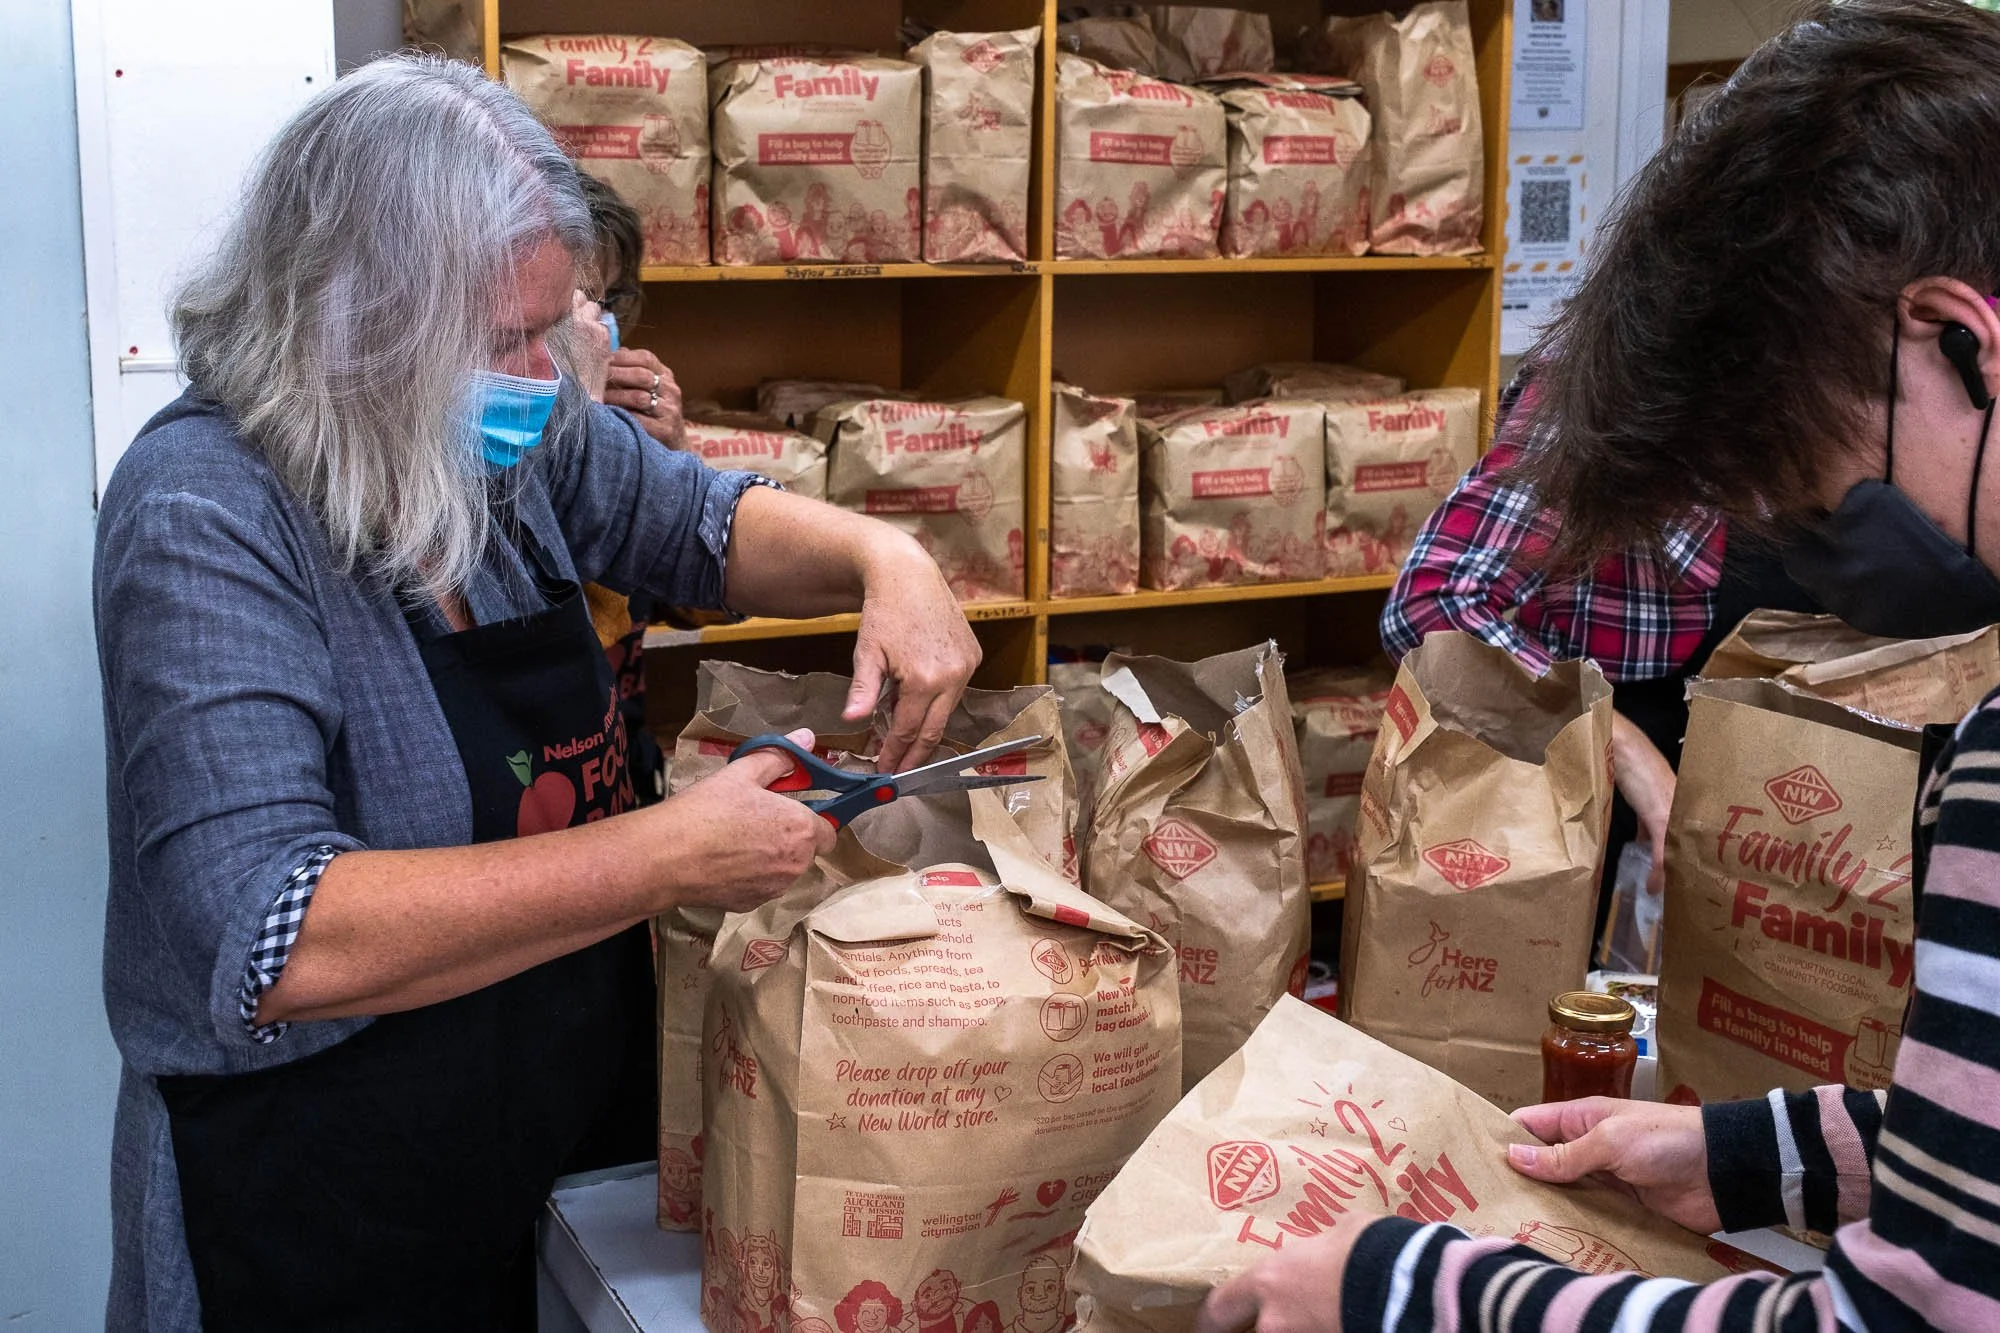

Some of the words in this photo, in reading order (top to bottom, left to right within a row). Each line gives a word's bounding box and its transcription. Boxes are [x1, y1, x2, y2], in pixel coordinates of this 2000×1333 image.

[637, 36, 653, 56] 2
[566, 59, 670, 95] Family
[774, 69, 880, 101] Family
[768, 139, 784, 149] Fill
[793, 139, 811, 151] bag
[812, 140, 822, 149] to
[823, 139, 844, 150] help
[777, 151, 807, 163] family
[819, 151, 843, 161] need
[1203, 408, 1291, 439] Family
[1367, 408, 1446, 432] Family
[885, 423, 983, 455] Family
[543, 731, 605, 763] Nelson
[1783, 784, 1824, 806] NW
[1156, 841, 1196, 859] NW
[1717, 804, 1868, 913] Family
[1731, 879, 1914, 989] Family
[888, 946, 944, 963] Anything
[945, 947, 973, 961] from
[1442, 947, 1498, 972] Here
[872, 965, 911, 979] foods,
[913, 963, 962, 978] spreads,
[964, 966, 984, 977] tea
[1180, 962, 1217, 985] NZ
[1764, 959, 1818, 986] COMMUNITY
[1820, 978, 1879, 1004] FOODBANKS
[1775, 952, 1835, 977] SUPPORTING
[1836, 970, 1868, 988] LOCAL
[833, 974, 858, 986] and
[899, 980, 922, 992] rice
[925, 979, 947, 990] and
[949, 980, 985, 993] pasta,
[987, 979, 1000, 989] to
[1459, 971, 1496, 993] NZ
[832, 993, 888, 1008] non-food
[891, 993, 925, 1008] items
[927, 995, 956, 1008] such
[958, 1000, 971, 1010] as
[974, 994, 1007, 1009] soap,
[1097, 989, 1119, 1003] New
[832, 1012, 899, 1029] toothpaste
[902, 1015, 925, 1028] and
[928, 1016, 988, 1029] shampoo.
[1096, 1001, 1131, 1018] match
[1095, 1020, 1116, 1033] bag
[1711, 993, 1732, 1013] Fill
[1735, 1006, 1744, 1017] a
[1748, 1006, 1776, 1032] bag
[1779, 1020, 1795, 1037] to
[1799, 1024, 1833, 1055] help
[1094, 1052, 1111, 1064] We
[1113, 1046, 1132, 1060] will
[1133, 1042, 1149, 1057] give
[1713, 1018, 1722, 1029] a
[1726, 1016, 1771, 1047] family
[1775, 1036, 1789, 1056] in
[1792, 1045, 1831, 1073] need
[726, 1039, 757, 1074] Here
[1092, 1062, 1134, 1079] directly
[1135, 1058, 1144, 1068] to
[1144, 1050, 1161, 1065] your
[835, 1059, 890, 1082] Please
[896, 1061, 938, 1088] drop
[943, 1058, 973, 1079] off
[970, 1059, 1012, 1085] your
[847, 1087, 925, 1108] donation
[931, 1085, 952, 1106] at
[955, 1086, 985, 1109] any
[1091, 1080, 1118, 1094] local
[858, 1113, 893, 1133] New
[898, 1108, 950, 1131] World
[953, 1107, 998, 1129] store.
[1334, 1100, 1407, 1166] 2
[1223, 1147, 1264, 1194] NW
[843, 1205, 864, 1214] CITY
[868, 1207, 905, 1216] MISSION
[844, 1197, 905, 1209] AUCKLAND
[922, 1211, 982, 1226] wellington
[920, 1222, 981, 1239] citymission
